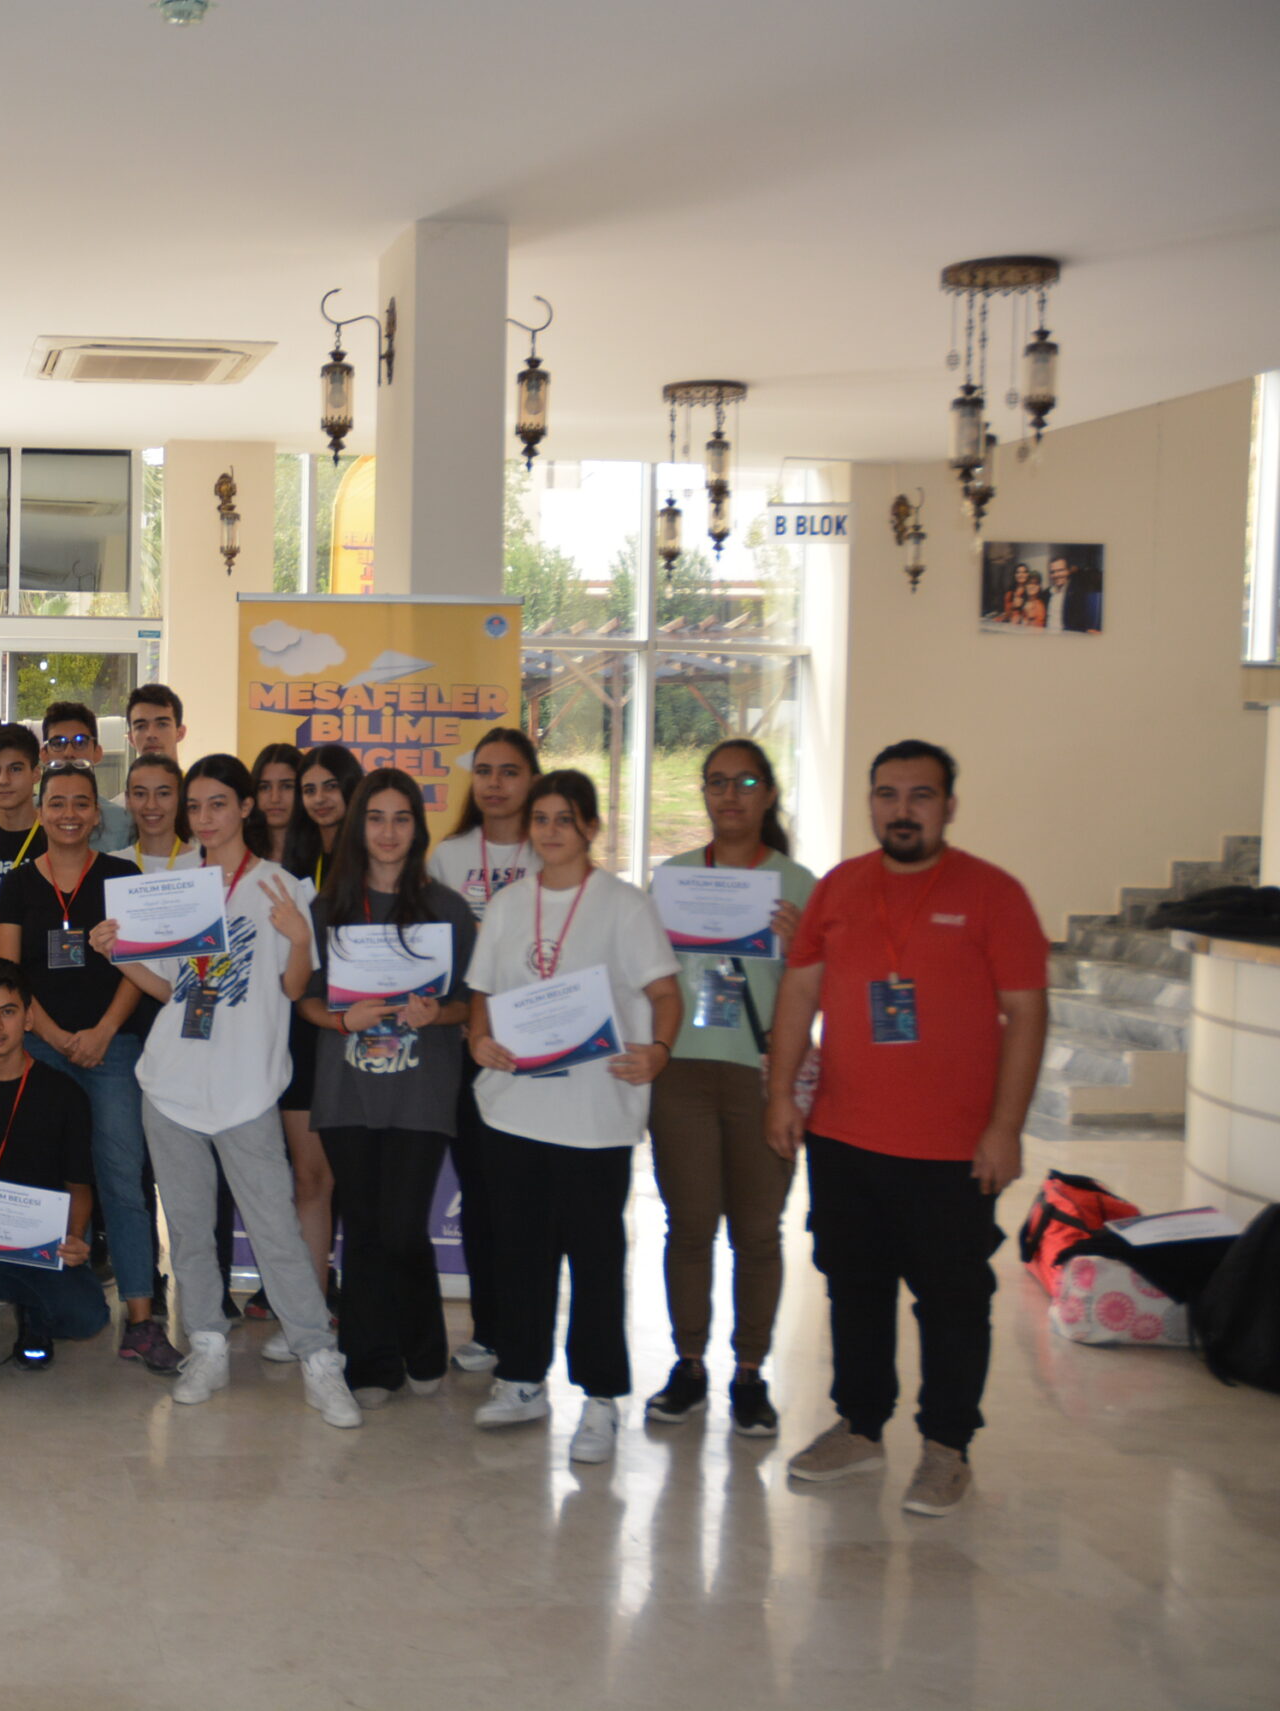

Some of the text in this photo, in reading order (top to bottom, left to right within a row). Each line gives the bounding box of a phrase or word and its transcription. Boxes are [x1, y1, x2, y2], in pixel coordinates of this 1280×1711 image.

[774, 515, 848, 536] B BLOK
[249, 681, 509, 717] MESAFELER
[308, 706, 462, 744] BİLİME
